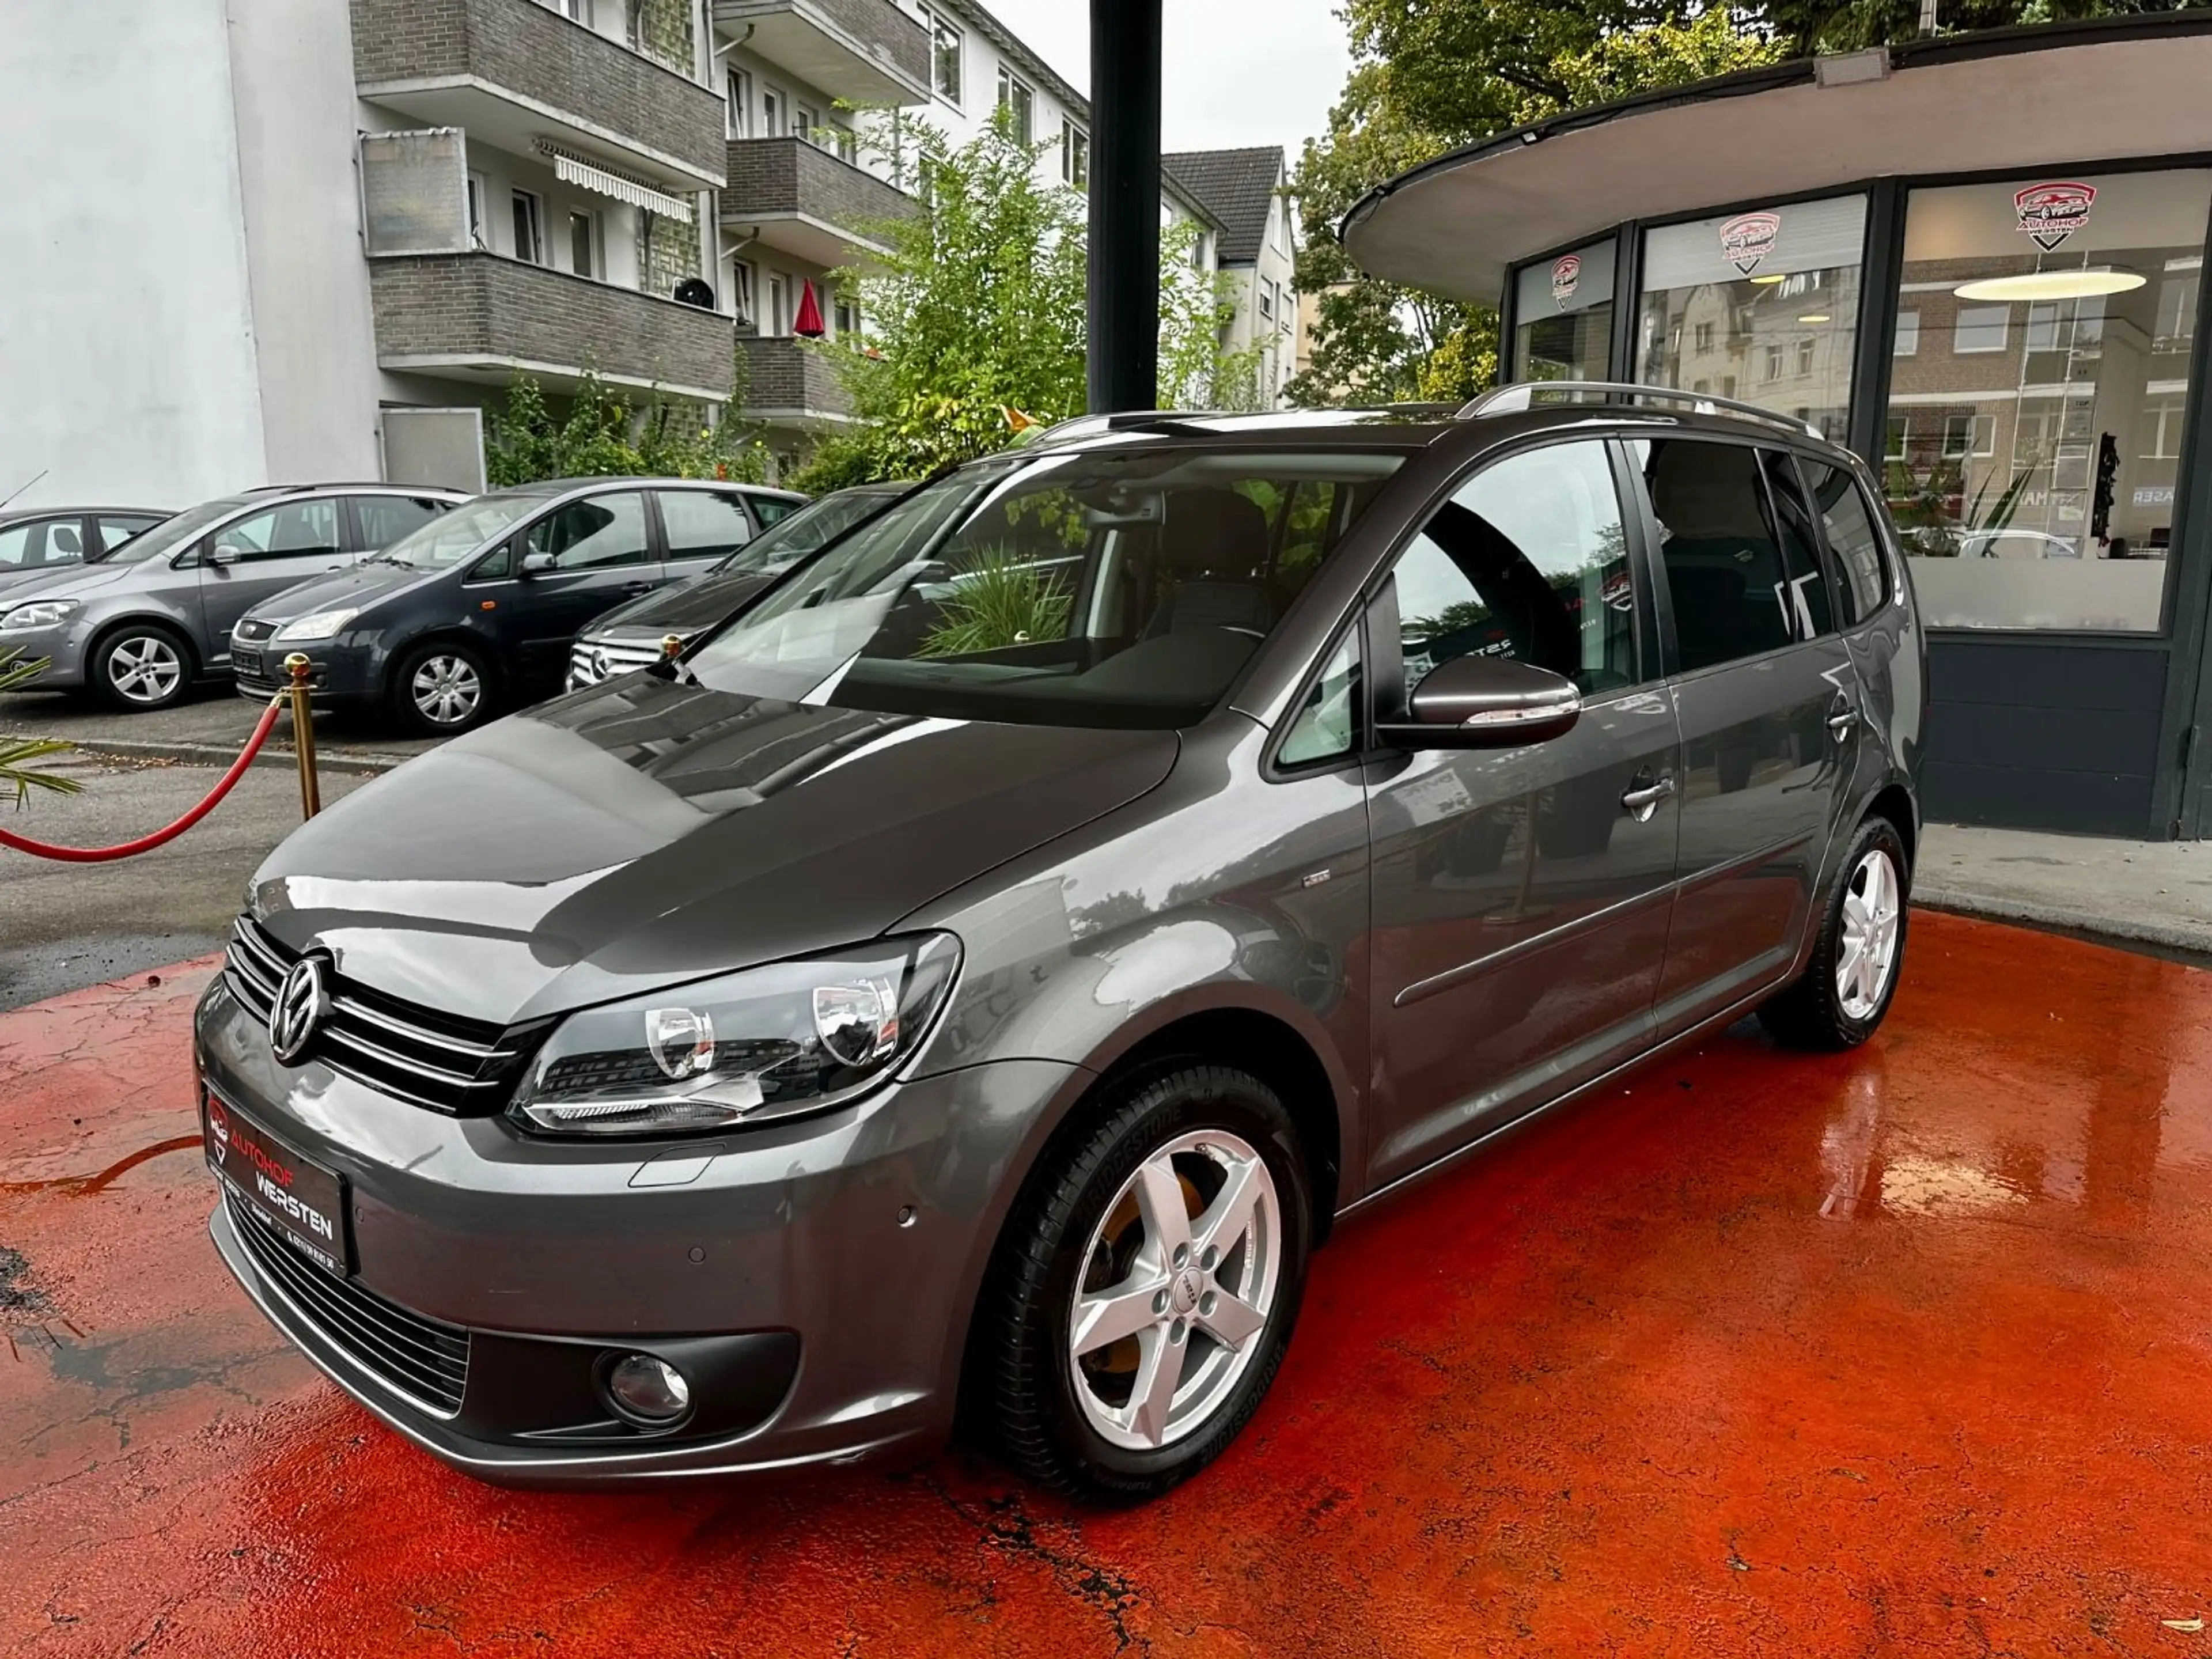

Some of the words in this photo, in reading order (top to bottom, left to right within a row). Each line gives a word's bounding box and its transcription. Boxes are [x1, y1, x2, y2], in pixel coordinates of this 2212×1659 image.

[2017, 218, 2087, 229] AUTOHOF
[230, 1130, 293, 1187] AUTOHOF
[256, 1171, 332, 1240] WERSTEN
